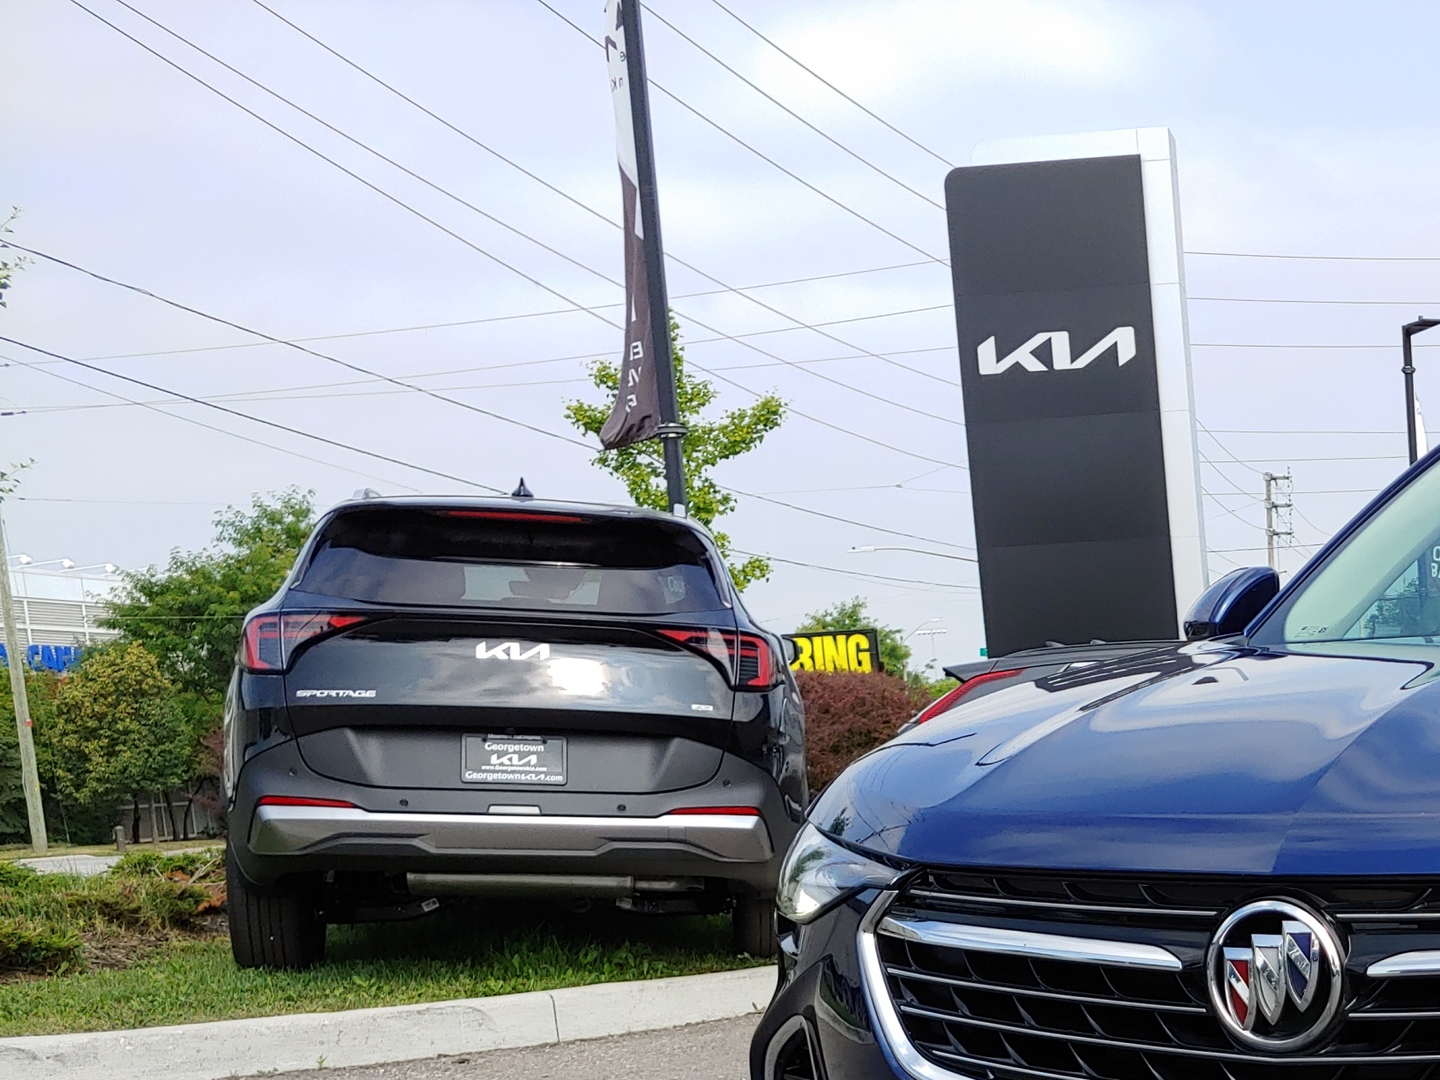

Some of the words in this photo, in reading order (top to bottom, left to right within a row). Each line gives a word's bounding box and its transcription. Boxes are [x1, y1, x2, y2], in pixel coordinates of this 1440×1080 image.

[977, 325, 1136, 375] KIA
[475, 641, 550, 661] KIA
[790, 633, 872, 674] RING
[295, 689, 377, 698] SPORTAGE
[484, 742, 545, 753] Georgetown
[490, 753, 538, 766] KIA
